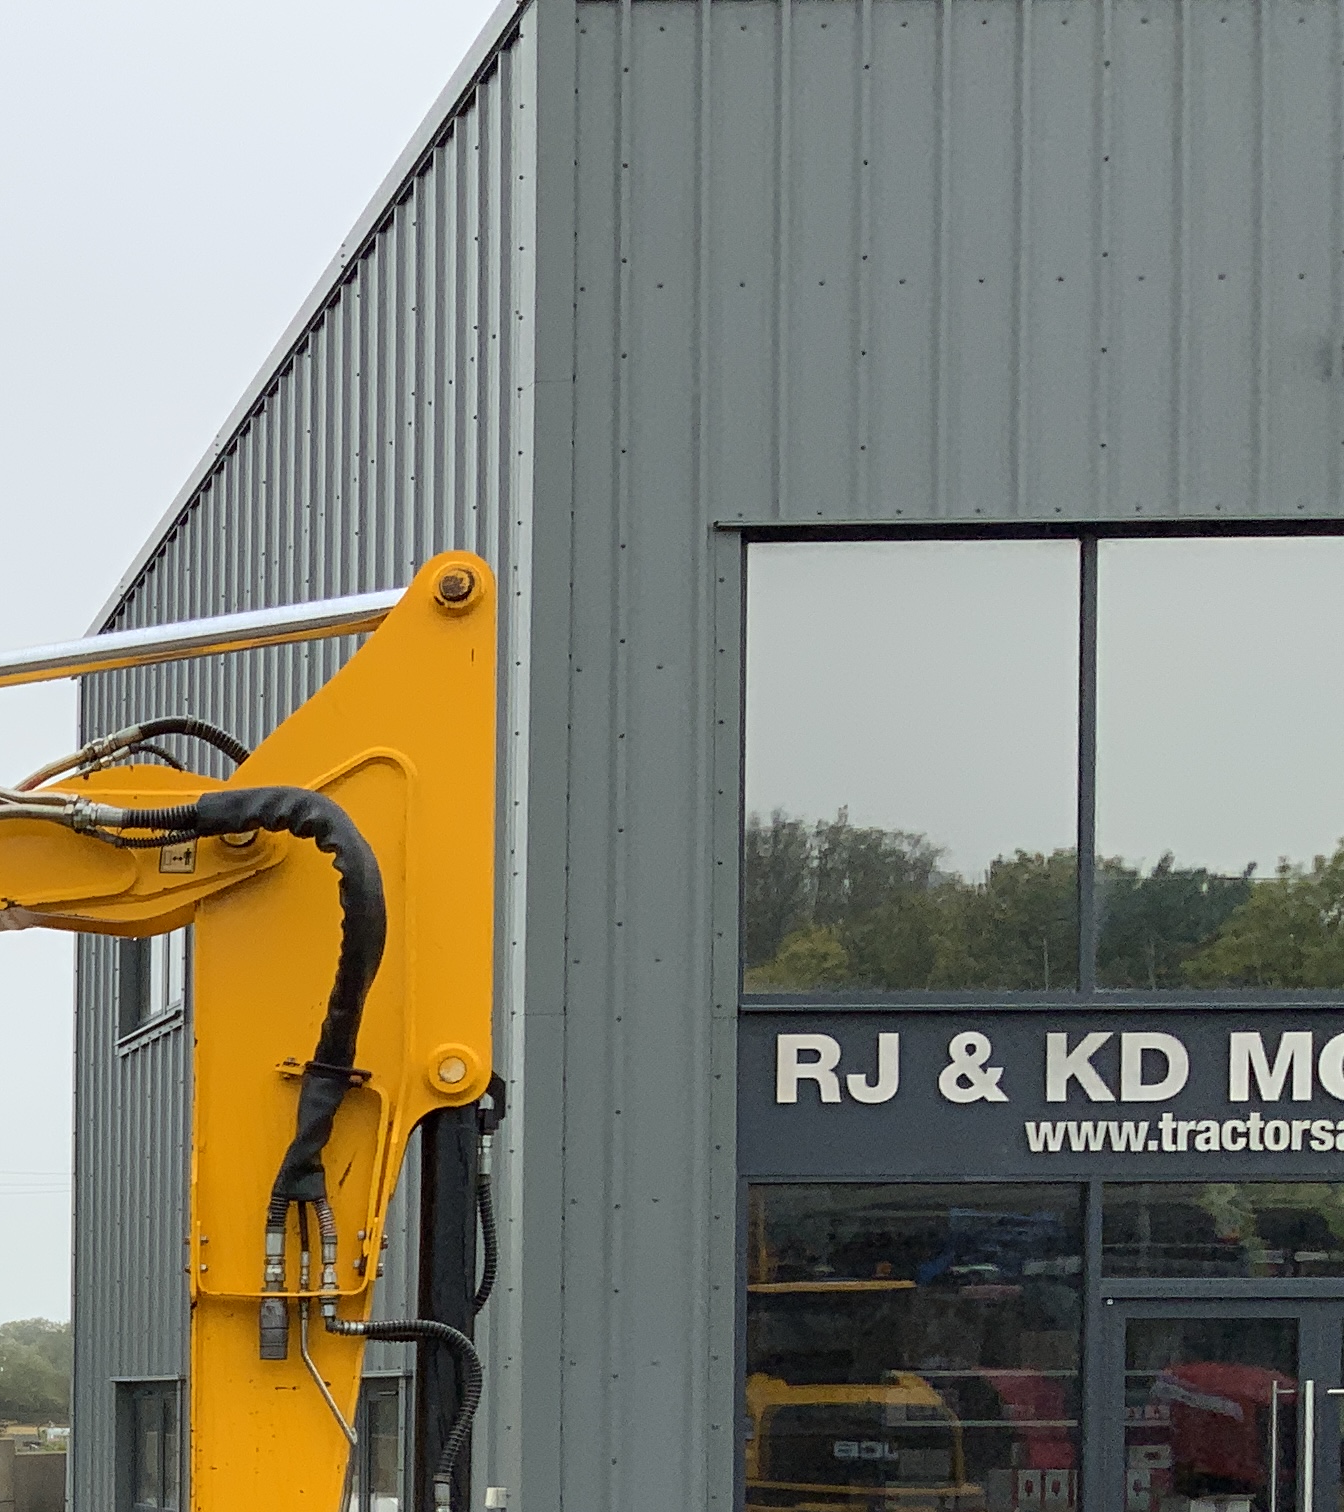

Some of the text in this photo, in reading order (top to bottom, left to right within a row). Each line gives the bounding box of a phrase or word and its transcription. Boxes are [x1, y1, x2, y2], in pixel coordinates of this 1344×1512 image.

[776, 1032, 902, 1105] RJ
[938, 1031, 1010, 1104] &
[1045, 1031, 1190, 1103] KD
